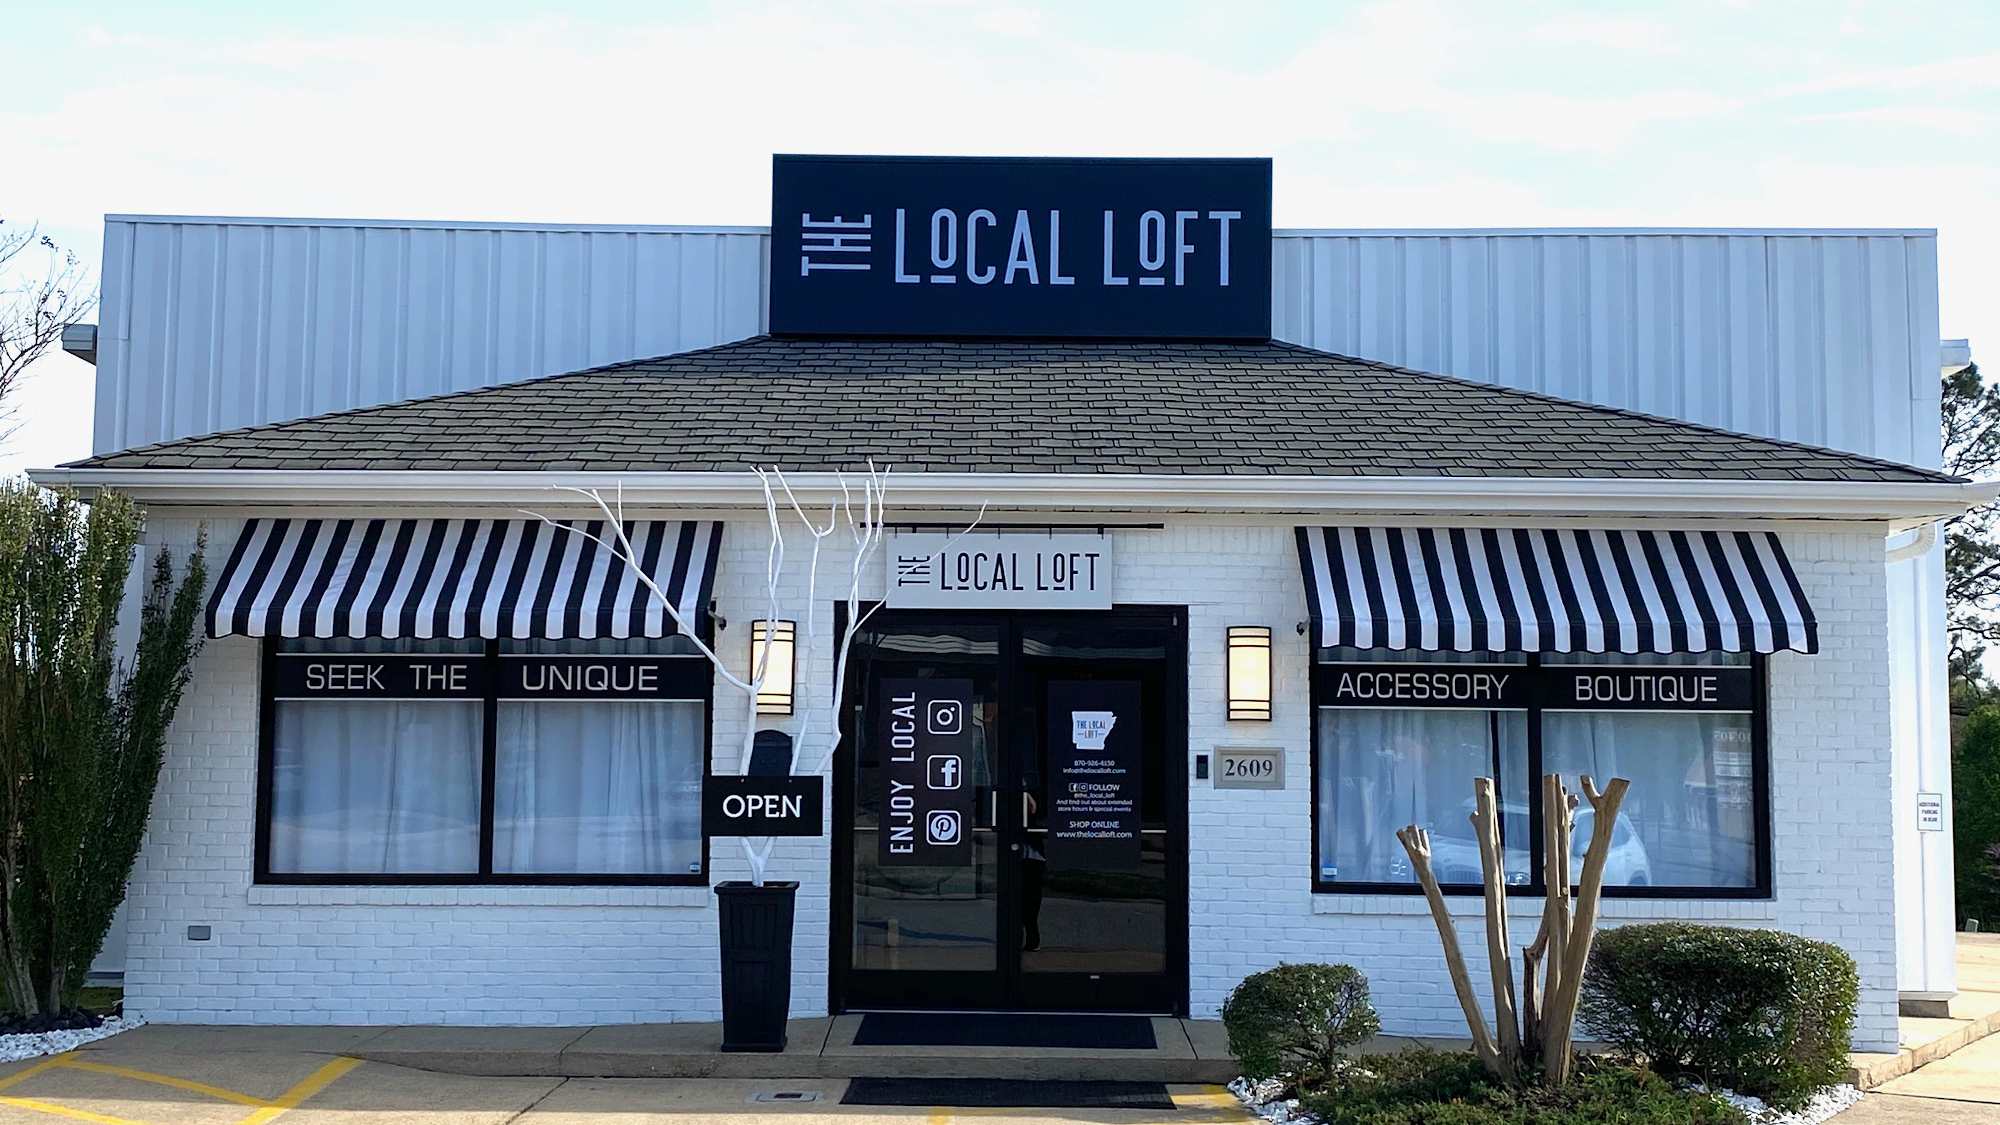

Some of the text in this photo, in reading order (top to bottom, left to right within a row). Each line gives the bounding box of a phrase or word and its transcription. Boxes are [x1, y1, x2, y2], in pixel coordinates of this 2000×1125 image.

[801, 208, 1242, 286] THE LOCAL LOFT
[898, 552, 1100, 591] THE LOCAL LOFT
[306, 664, 659, 691] SEEK THE UNIQUE
[1336, 672, 1718, 702] ACCESSORY BOUTIQUE
[1077, 720, 1106, 729] THE LOCAL
[1084, 730, 1098, 738] LOFT
[890, 692, 916, 853] ENJOY LOCAL
[1225, 759, 1273, 777] 2609
[1089, 783, 1121, 792] FOLLOW
[722, 794, 803, 818] OPEN
[1056, 830, 1133, 839] www.thelocalloft.com
[1069, 820, 1120, 829] SHOP ONLINE
